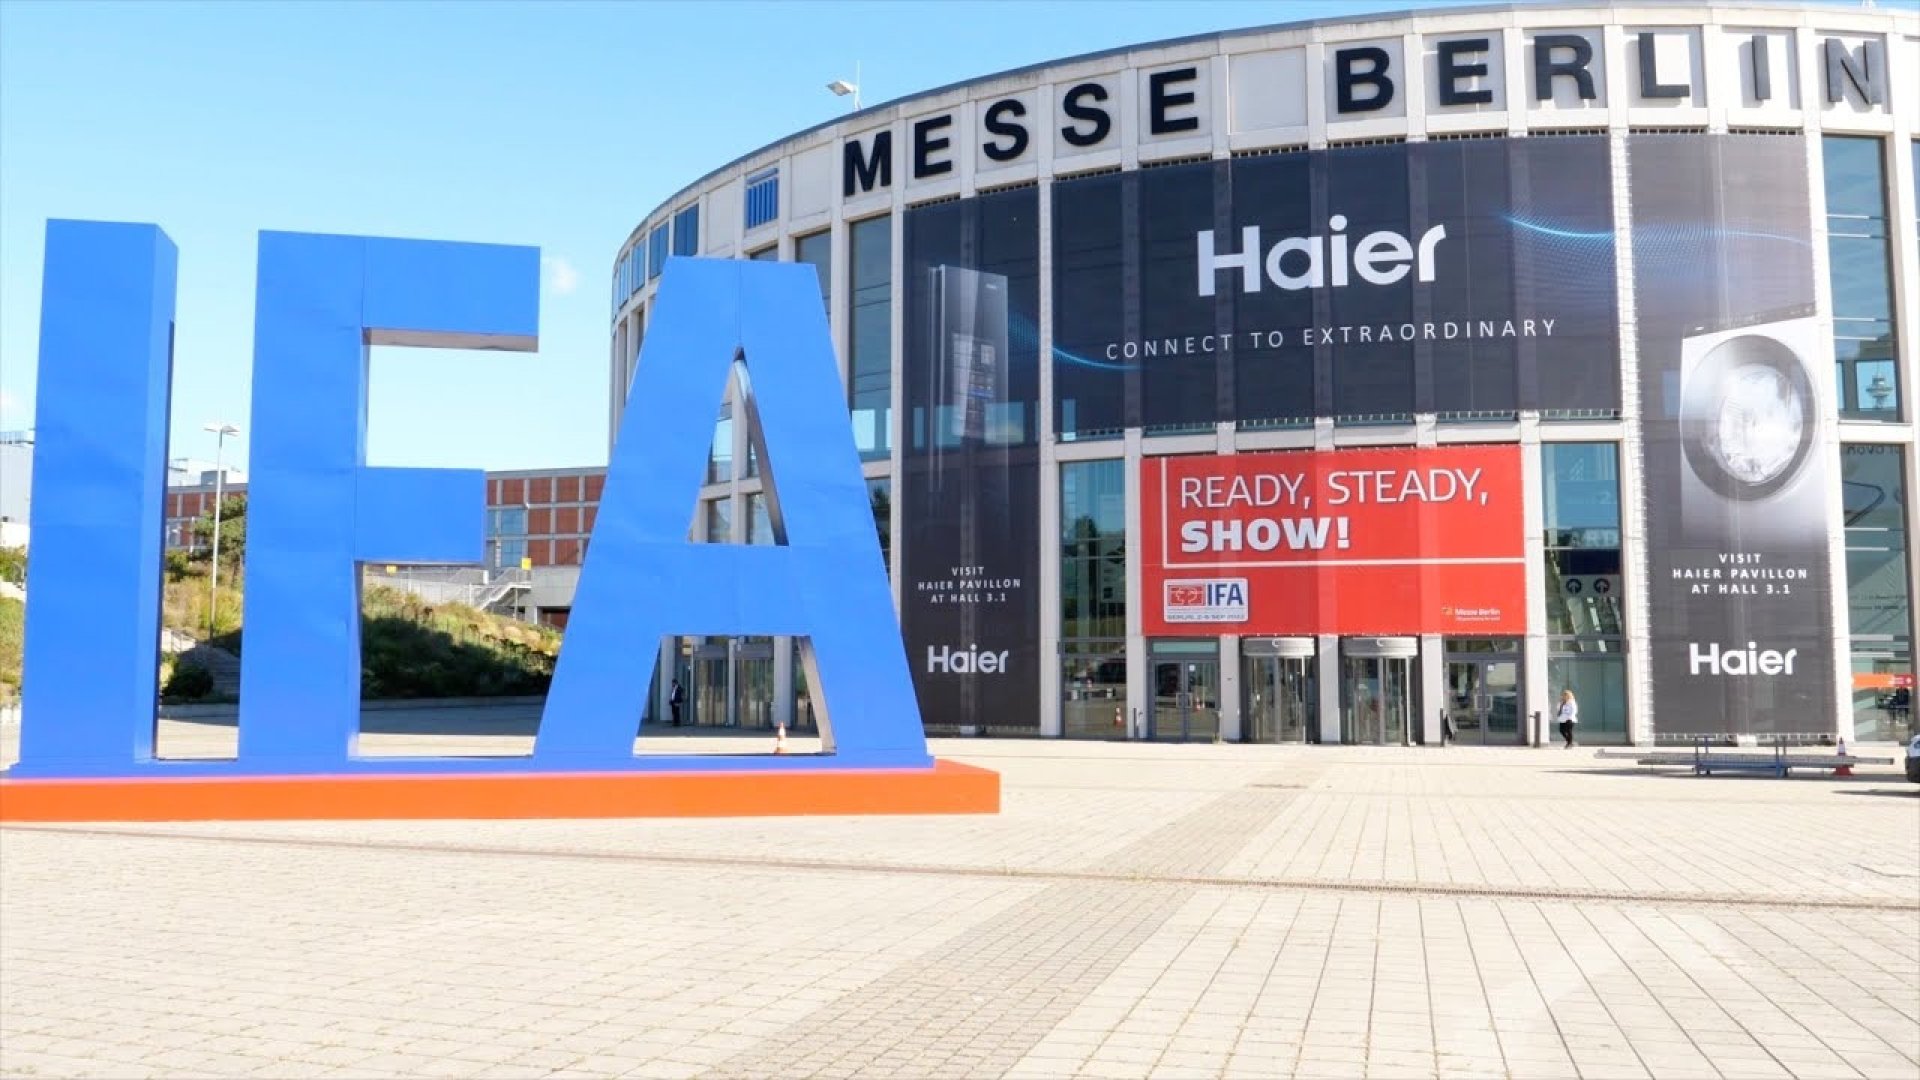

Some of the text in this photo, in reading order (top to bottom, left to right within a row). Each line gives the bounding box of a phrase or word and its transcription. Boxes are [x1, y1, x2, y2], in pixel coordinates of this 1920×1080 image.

[843, 31, 1888, 197] MESSE BERLIN
[1196, 214, 1447, 297] Haier
[1105, 318, 1557, 361] CONNECT TO EXTRAORDINARY
[18, 218, 934, 772] IFA
[1180, 467, 1489, 509] READY, STEADY,
[1180, 516, 1351, 553] SHOW!
[951, 566, 985, 577] VISIT
[1672, 568, 1807, 580] HAIER PAVILLON
[1718, 553, 1762, 564] VISIT
[917, 578, 1021, 591] HAIER PAVILLON
[930, 593, 1006, 603] AT HALL 3.1
[1206, 583, 1244, 607] IFA
[1691, 584, 1791, 595] AT HALL 3.1
[927, 643, 1009, 674] Haier
[1688, 641, 1798, 676] Haier
